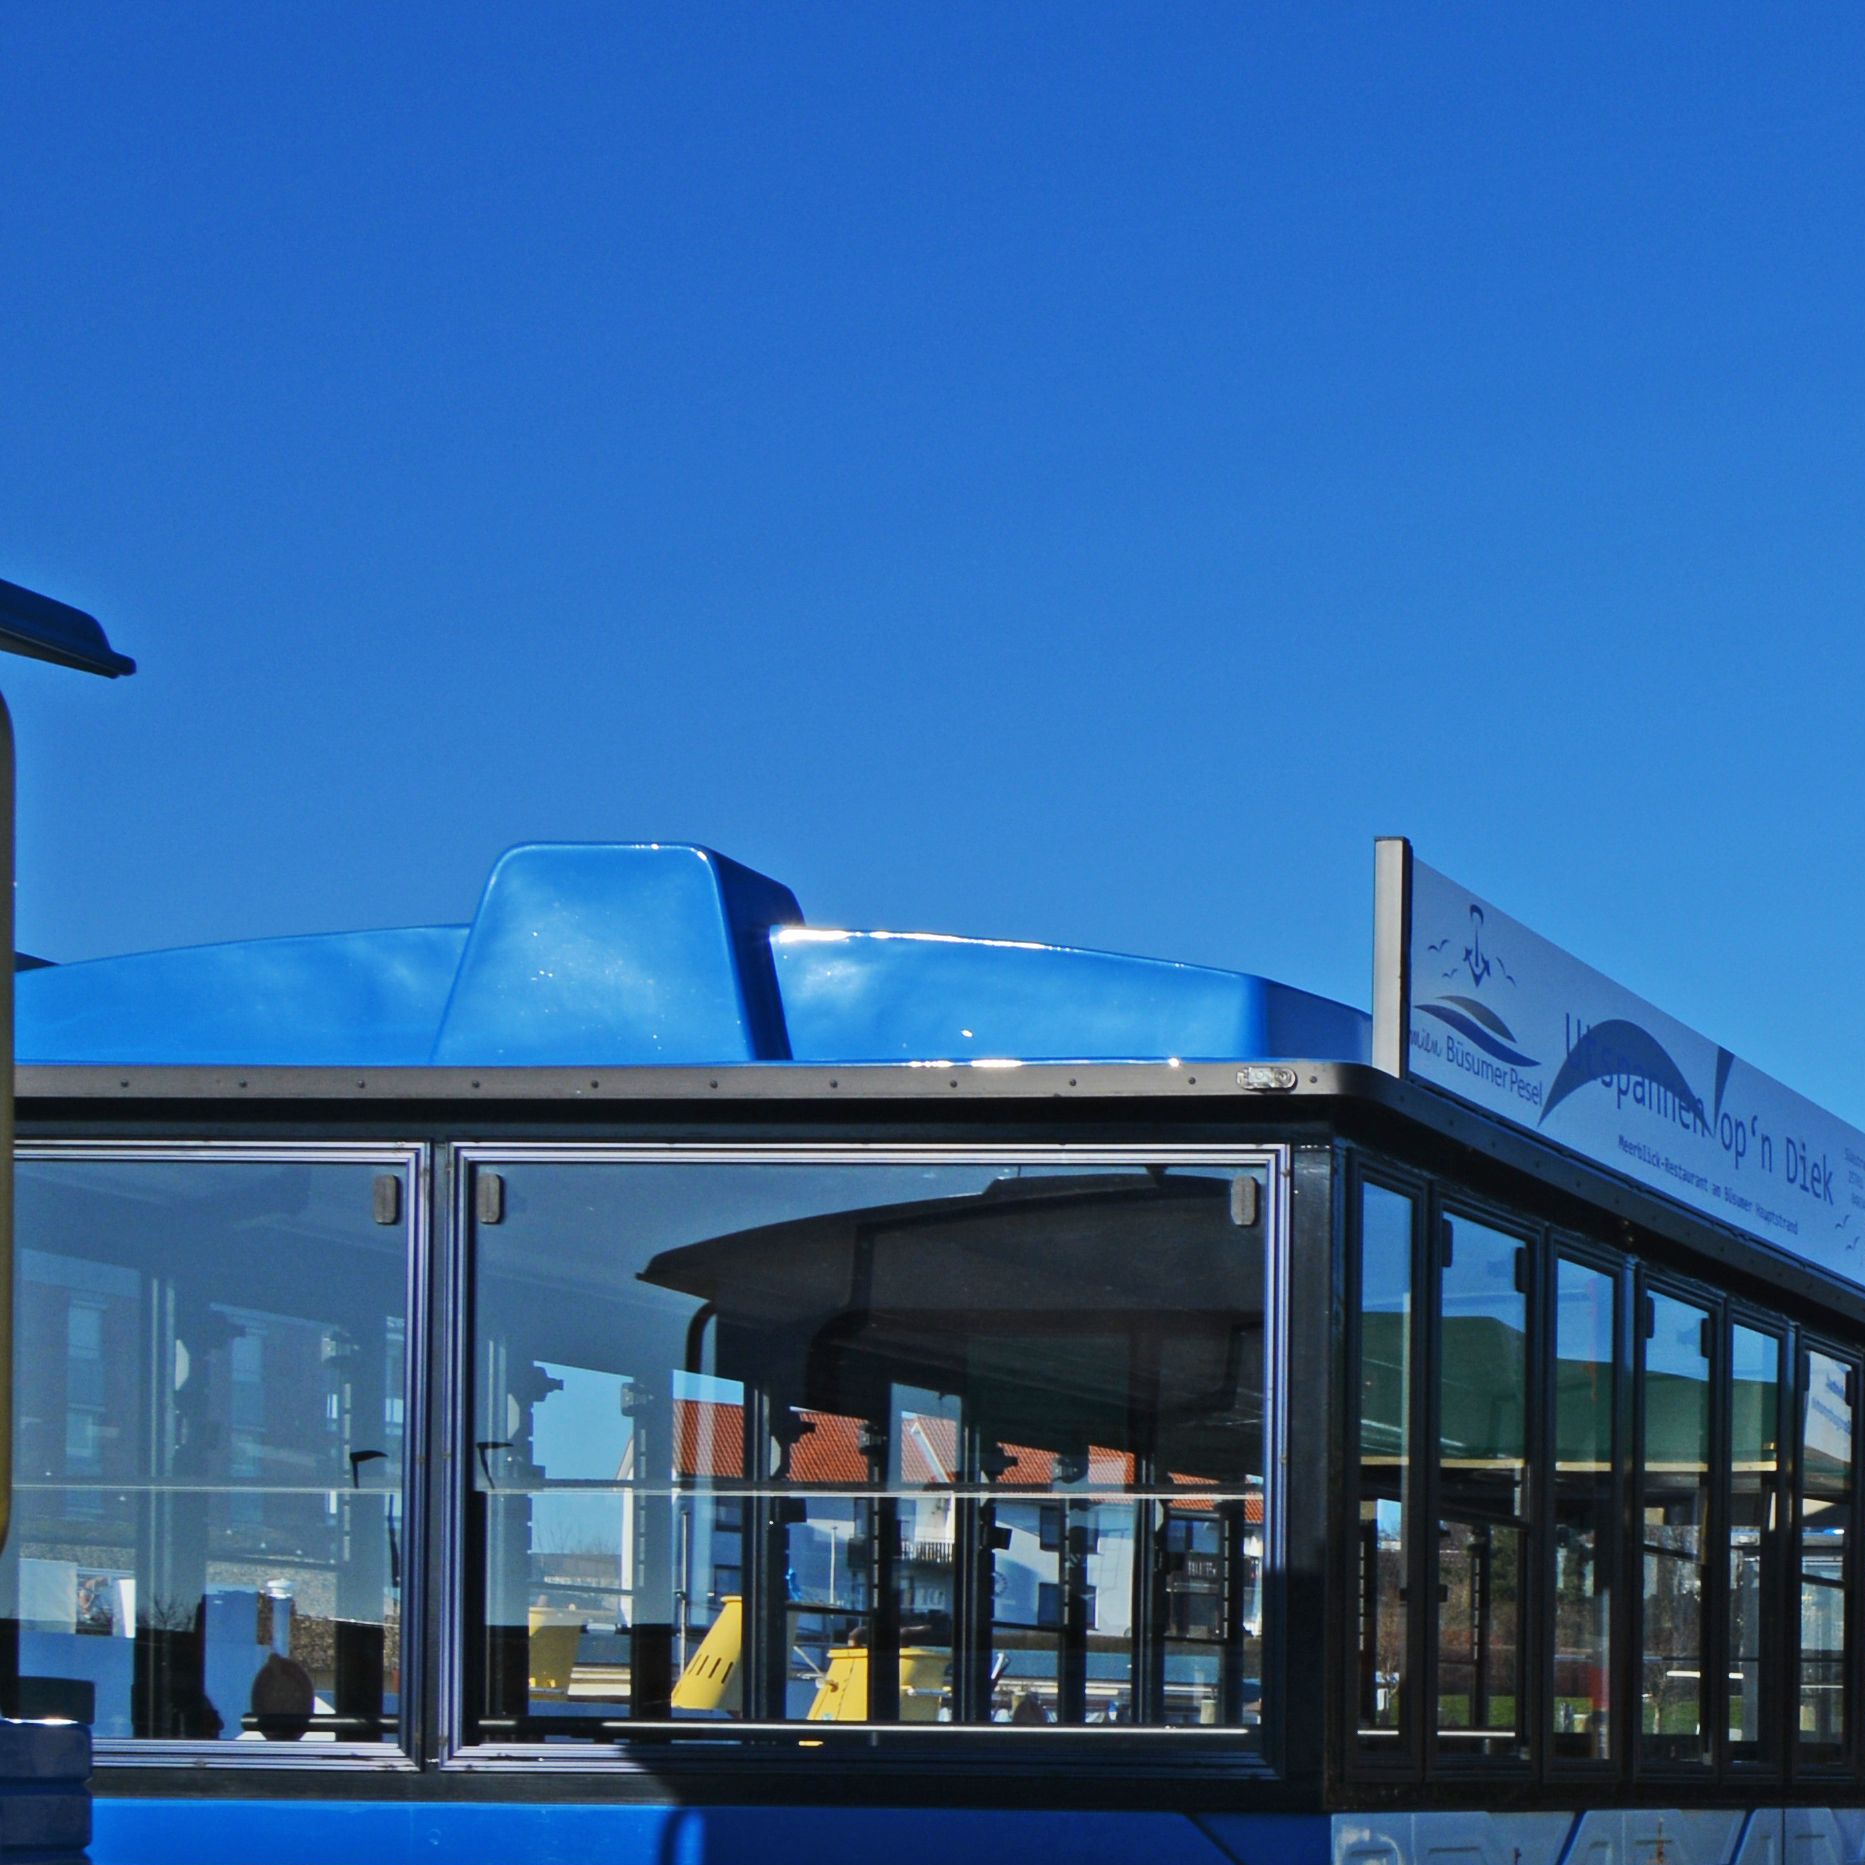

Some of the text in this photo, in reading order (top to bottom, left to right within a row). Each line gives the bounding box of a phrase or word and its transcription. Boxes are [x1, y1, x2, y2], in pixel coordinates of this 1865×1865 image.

[1445, 1035, 1510, 1091] Büsumer
[1510, 1067, 1543, 1107] Pesel
[1784, 1136, 1834, 1206] Diek
